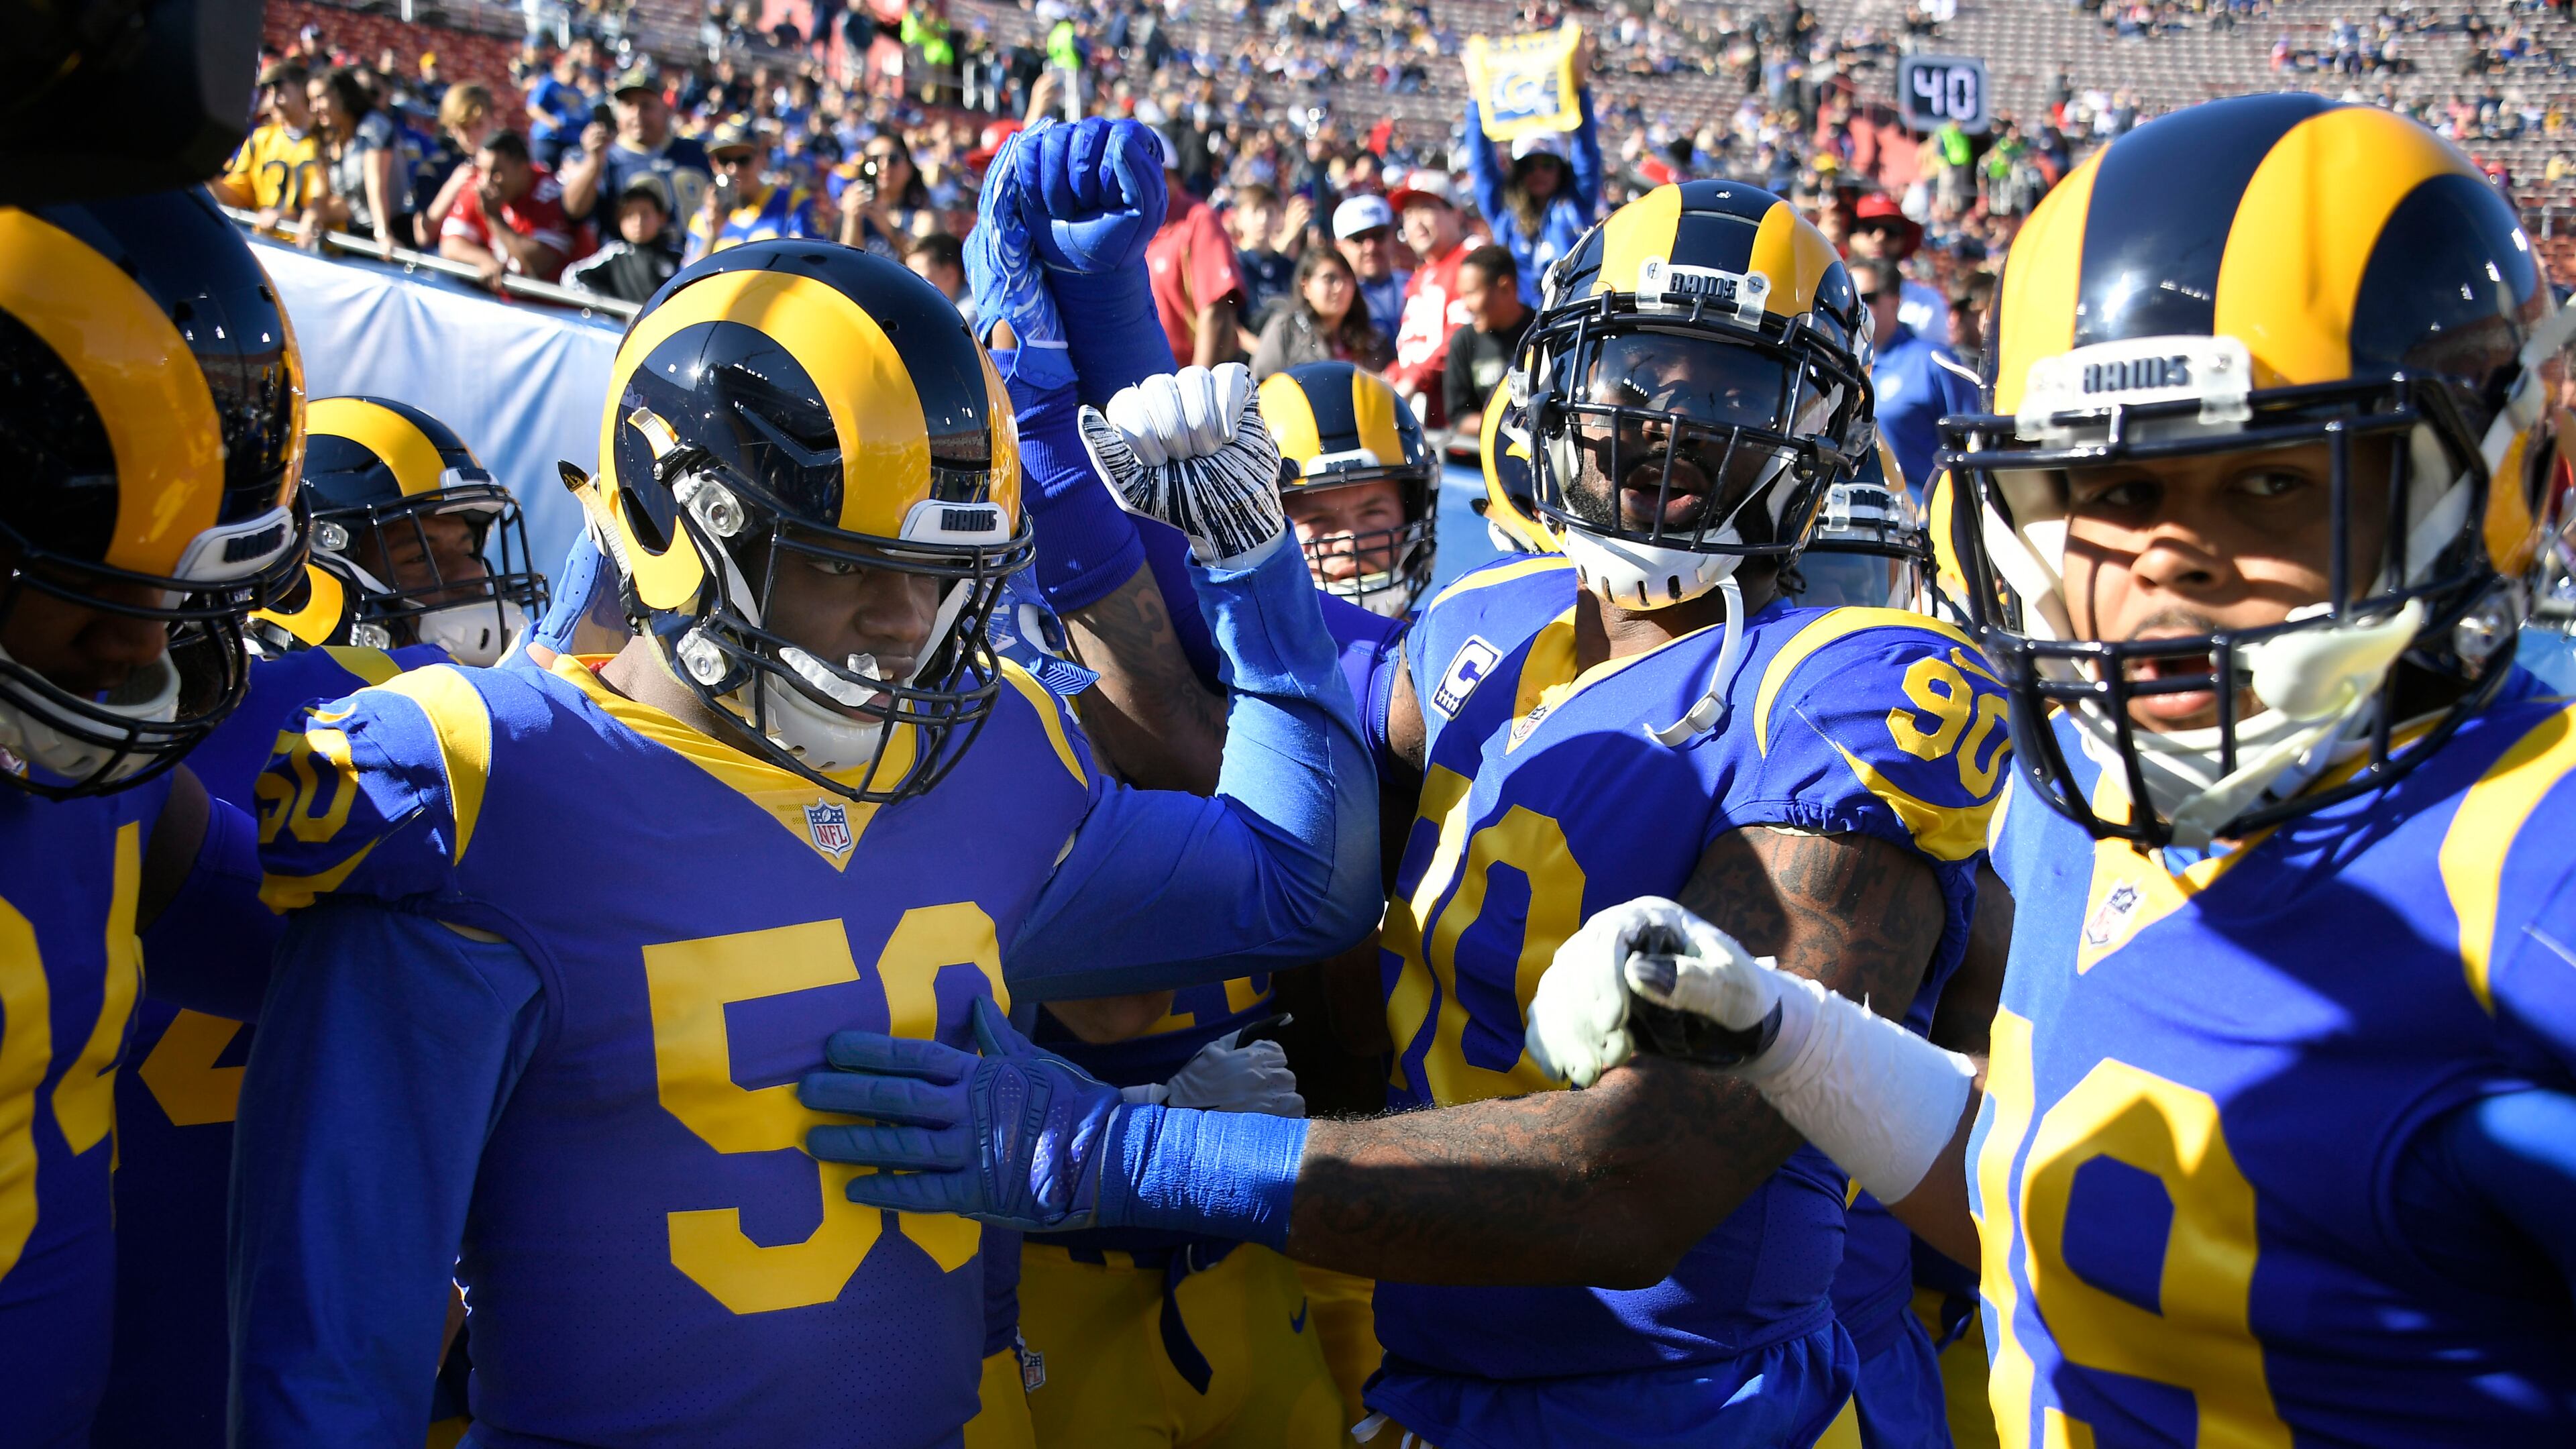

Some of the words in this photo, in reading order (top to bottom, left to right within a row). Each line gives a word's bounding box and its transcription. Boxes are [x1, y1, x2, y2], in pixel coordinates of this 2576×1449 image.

[1913, 67, 1977, 119] 40
[1668, 272, 1737, 300] RAMS
[2083, 355, 2188, 394] RAMS
[1850, 490, 1889, 511] AMS
[941, 509, 998, 531] RAMS
[1445, 643, 1495, 700] C
[1886, 656, 2012, 800] 90
[816, 824, 849, 847] NFL
